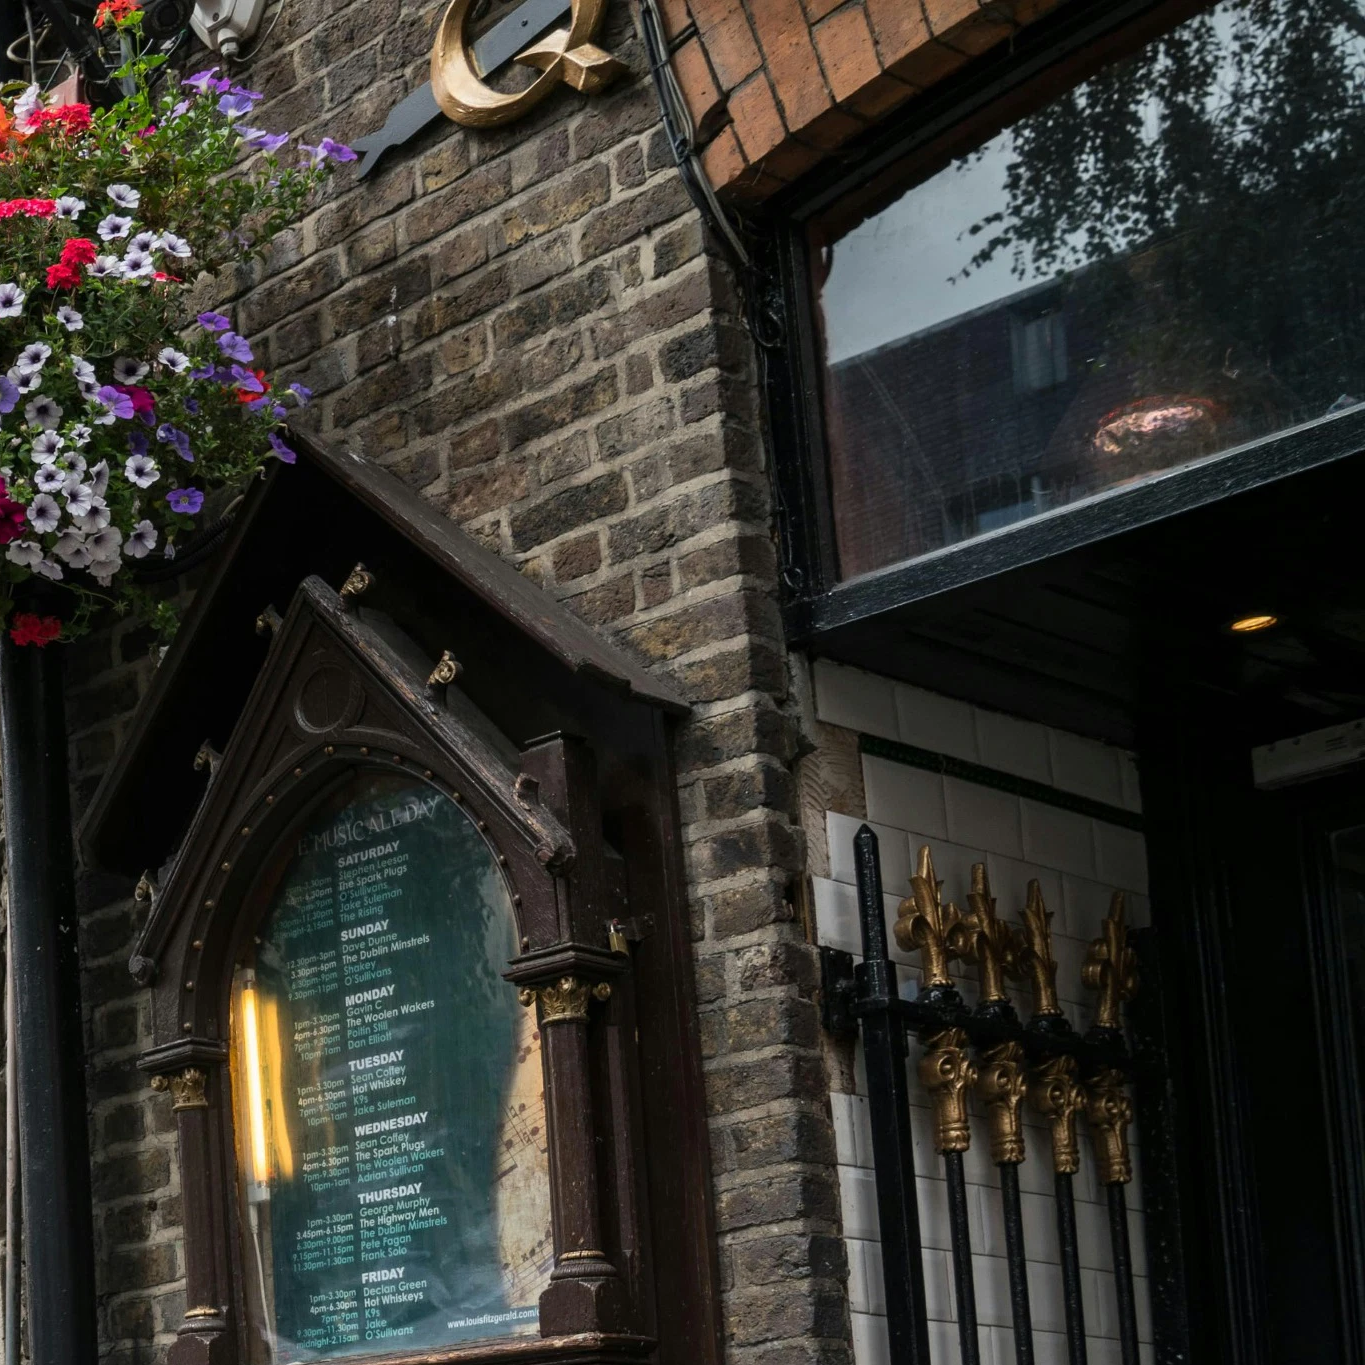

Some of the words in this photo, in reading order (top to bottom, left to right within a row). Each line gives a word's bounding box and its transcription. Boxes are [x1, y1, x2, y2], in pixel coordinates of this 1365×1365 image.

[314, 820, 366, 852] MUSIC
[369, 809, 401, 834] ALL
[404, 796, 440, 822] DAY
[338, 841, 399, 868] SATURDAY
[338, 863, 375, 880] Stephen
[377, 853, 409, 868] Leeson
[338, 881, 354, 891] The
[356, 872, 382, 888] Spark
[384, 864, 408, 878] Plugs
[339, 881, 388, 901] O'Sullivans
[339, 900, 361, 912] Jake
[363, 888, 402, 906] Suleman
[339, 912, 355, 923] The
[358, 905, 383, 919] Rising
[341, 919, 389, 941] SUNDAY
[342, 941, 366, 954] Dave
[368, 932, 398, 944] Dunne
[291, 961, 337, 980] 3.30pm-6pm
[342, 955, 358, 965] The
[360, 946, 388, 960] Dublin
[390, 934, 430, 952] Minstrels
[343, 960, 376, 976] Shakey
[344, 966, 392, 987] O'Sullivans
[345, 984, 396, 1007] MONDAY
[294, 1012, 340, 1031] 1pm-3.30pm
[346, 1003, 373, 1017] Gavin
[375, 1000, 383, 1010] C
[294, 1024, 340, 1042] 4pm-6.30pm
[346, 1018, 362, 1028] The
[364, 1009, 398, 1024] Woolen
[400, 999, 435, 1015] Wakers
[300, 1046, 341, 1062] 10pm-1am
[348, 1040, 366, 1050] Dan
[368, 1032, 392, 1046] Elliott
[348, 1049, 405, 1072] TUESDAY
[297, 1079, 345, 1096] 1pm-3.30pm
[351, 1072, 374, 1085] Sean
[375, 1065, 406, 1079] Coffey
[298, 1090, 346, 1107] 4pm-6.30pm
[352, 1084, 368, 1095] Hot
[369, 1075, 407, 1091] Whiskey
[307, 1111, 348, 1127] 10pm-1am
[353, 1105, 375, 1117] Jake
[377, 1094, 416, 1111] Suleman
[353, 1095, 369, 1106] K9s
[354, 1111, 429, 1137] WEDNESDAY
[302, 1144, 349, 1161] 1pm-3.30pm
[355, 1139, 378, 1151] Sean
[379, 1131, 410, 1146] Coffey
[302, 1155, 349, 1172] 4pm-6.30pm
[355, 1151, 371, 1162] The
[373, 1145, 399, 1159] Spark
[401, 1139, 425, 1153] Plugs
[303, 1166, 350, 1184] 7pm-9.30pm
[356, 1162, 372, 1173] The
[373, 1155, 408, 1169] Woolen
[410, 1147, 445, 1160] Wakers
[311, 1178, 351, 1192] 10pm-1am
[357, 1170, 387, 1184] Adrian
[389, 1163, 424, 1178] Sullivan
[358, 1182, 423, 1205] THURSDAY
[296, 1223, 354, 1241] 3.45pm-6.15pm
[360, 1218, 375, 1229] The
[377, 1211, 416, 1227] Highway
[418, 1207, 439, 1217] Men
[307, 1212, 353, 1228] 1pm-3.30pm
[359, 1203, 394, 1218] George
[396, 1197, 431, 1212] Murphy
[296, 1234, 354, 1251] 6.30pm-9.00pm
[360, 1229, 375, 1240] The
[377, 1223, 406, 1236] Dublin
[408, 1216, 448, 1231] Minstrels
[292, 1245, 354, 1262] 9.15pm-11.15pm
[360, 1239, 381, 1251] Pete
[382, 1234, 412, 1248] Fagan
[293, 1256, 355, 1272] 11.30pm-1.30am
[361, 1249, 386, 1261] Frank
[388, 1245, 408, 1257] Solo
[361, 1266, 405, 1284] FRIDAY
[309, 1289, 356, 1304] 1pm-3.30pm
[363, 1284, 396, 1297] Declan
[398, 1279, 427, 1292] Green
[309, 1300, 357, 1315] 4pm-6.30pm
[364, 1298, 379, 1308] Hot
[381, 1290, 424, 1305] Whiskeys
[297, 1322, 359, 1338] 9.30pm-11.30pm
[365, 1318, 387, 1329] Jake
[321, 1311, 358, 1324] 7pm-9pm
[365, 1308, 381, 1318] K9s
[365, 1326, 414, 1341] O'Sullivans
